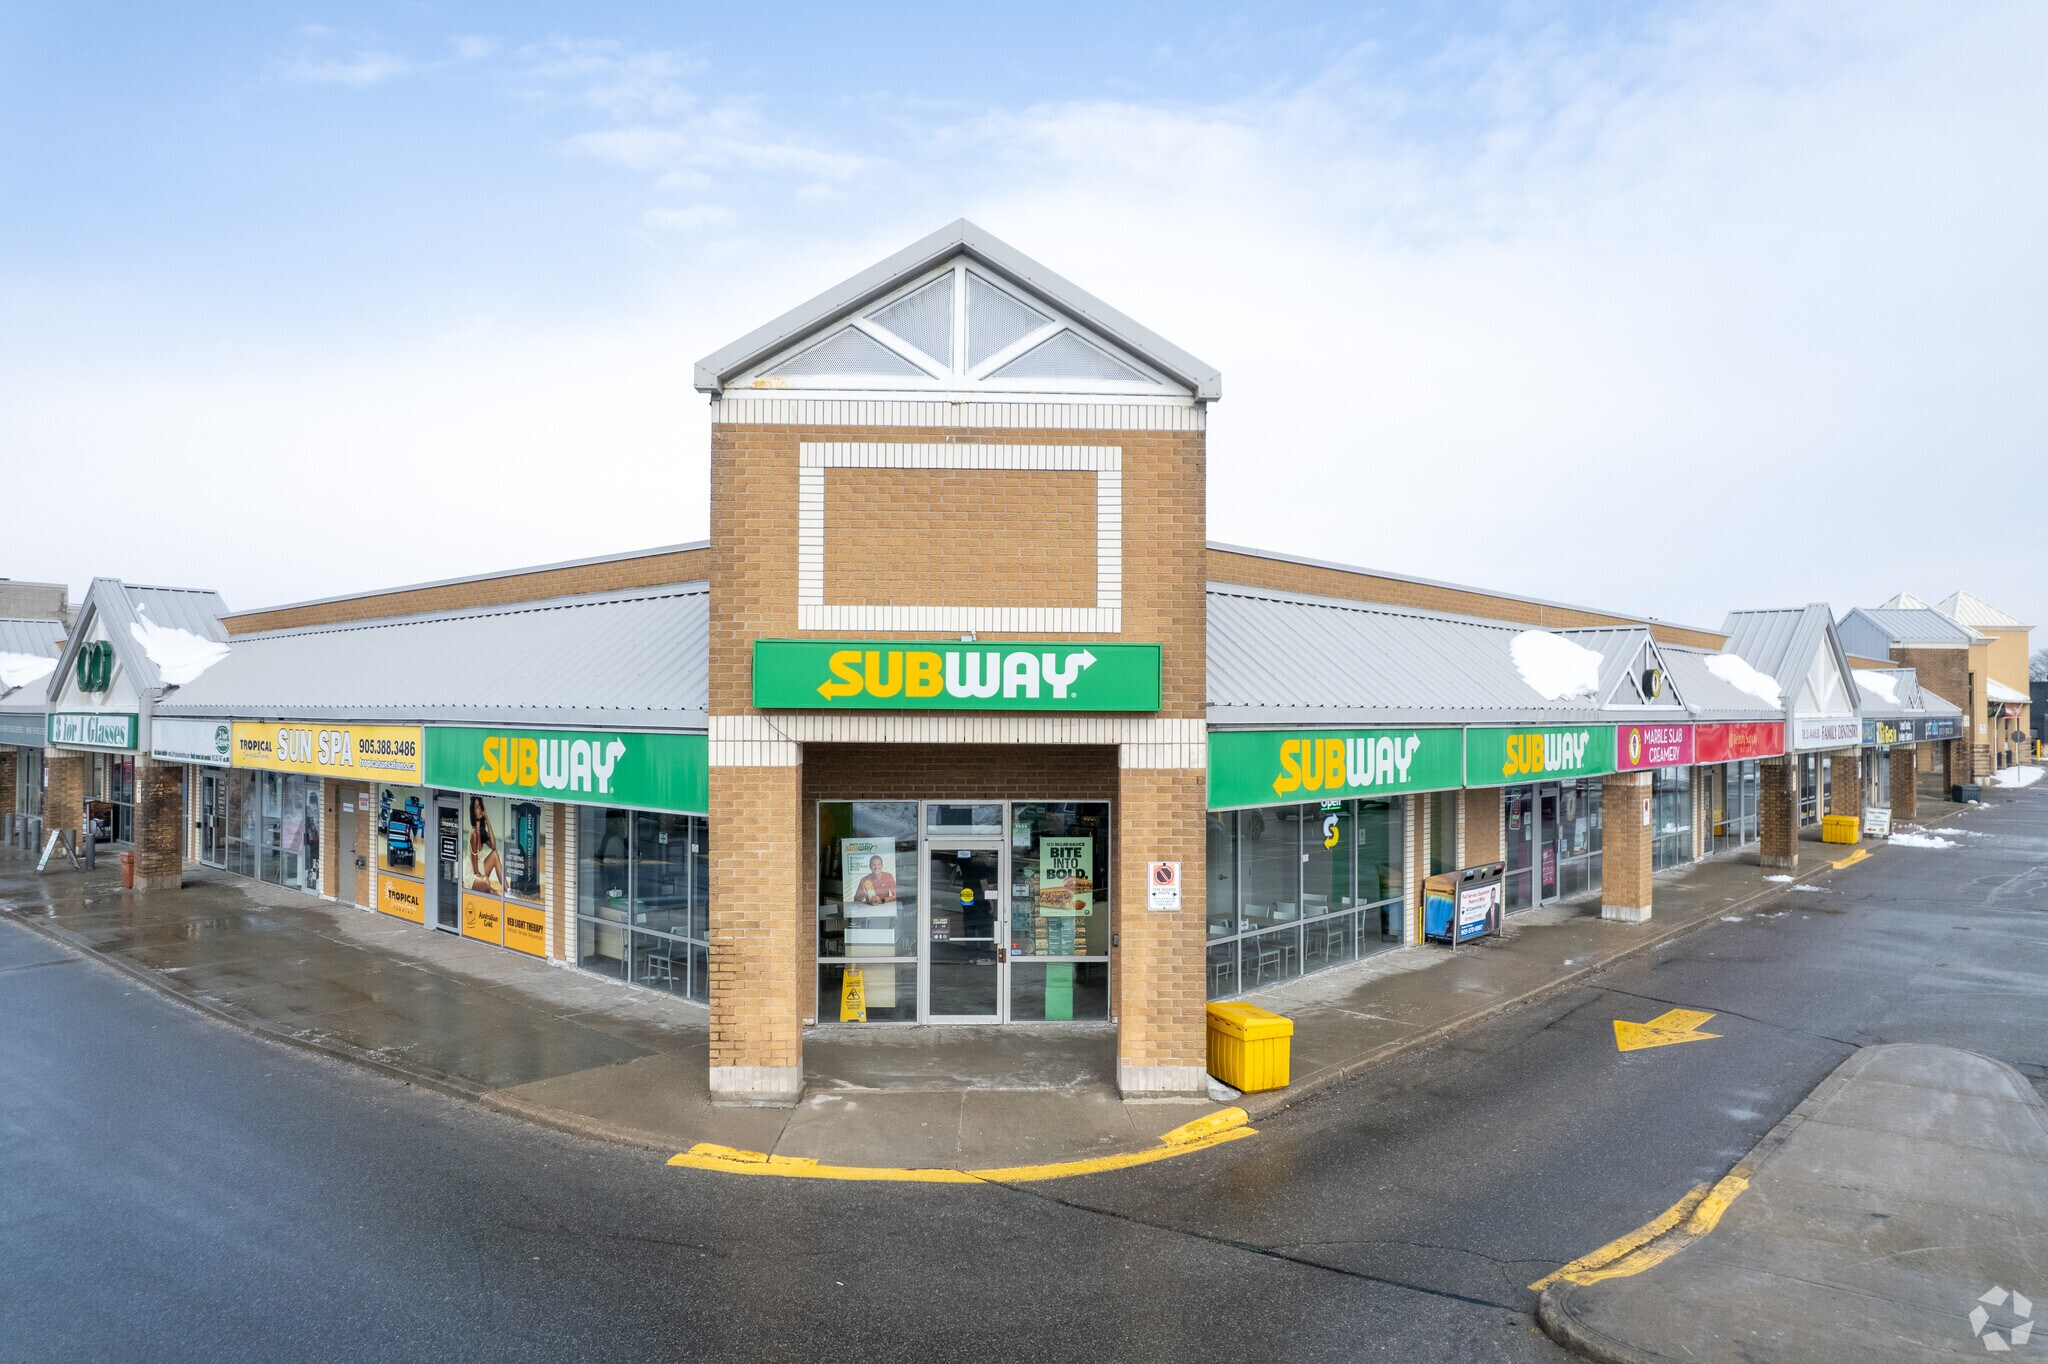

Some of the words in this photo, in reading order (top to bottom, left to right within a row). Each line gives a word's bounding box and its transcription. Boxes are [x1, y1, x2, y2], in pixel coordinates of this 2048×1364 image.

[816, 648, 1097, 702] SUBWAY
[55, 716, 61, 741] 3
[63, 716, 78, 742] for
[87, 717, 125, 745] Glasses
[1644, 729, 1668, 745] MARBLE
[1668, 727, 1682, 743] SLAB
[1821, 725, 1837, 740] FAMILY
[1838, 724, 1858, 739] DENTISTRY
[240, 739, 272, 752] TROPICAL
[277, 728, 312, 763] SUN
[318, 730, 353, 766] SPA
[359, 739, 416, 756] 905.388.3486
[1502, 728, 1590, 778] SUBWAY
[1649, 746, 1680, 763] CREAMERY
[359, 757, 416, 771] tropicalsunsations.ca
[477, 736, 627, 793] SUBWAY
[1272, 732, 1421, 797] SUBWAY
[1050, 847, 1082, 858] BITE
[1053, 857, 1079, 869] INTO
[388, 890, 419, 906] TROPICAL
[479, 911, 498, 922] Australian
[484, 920, 493, 928] Gold
[507, 917, 515, 927] RED
[515, 919, 526, 930] LIGHT
[527, 922, 544, 935] THERAPY
